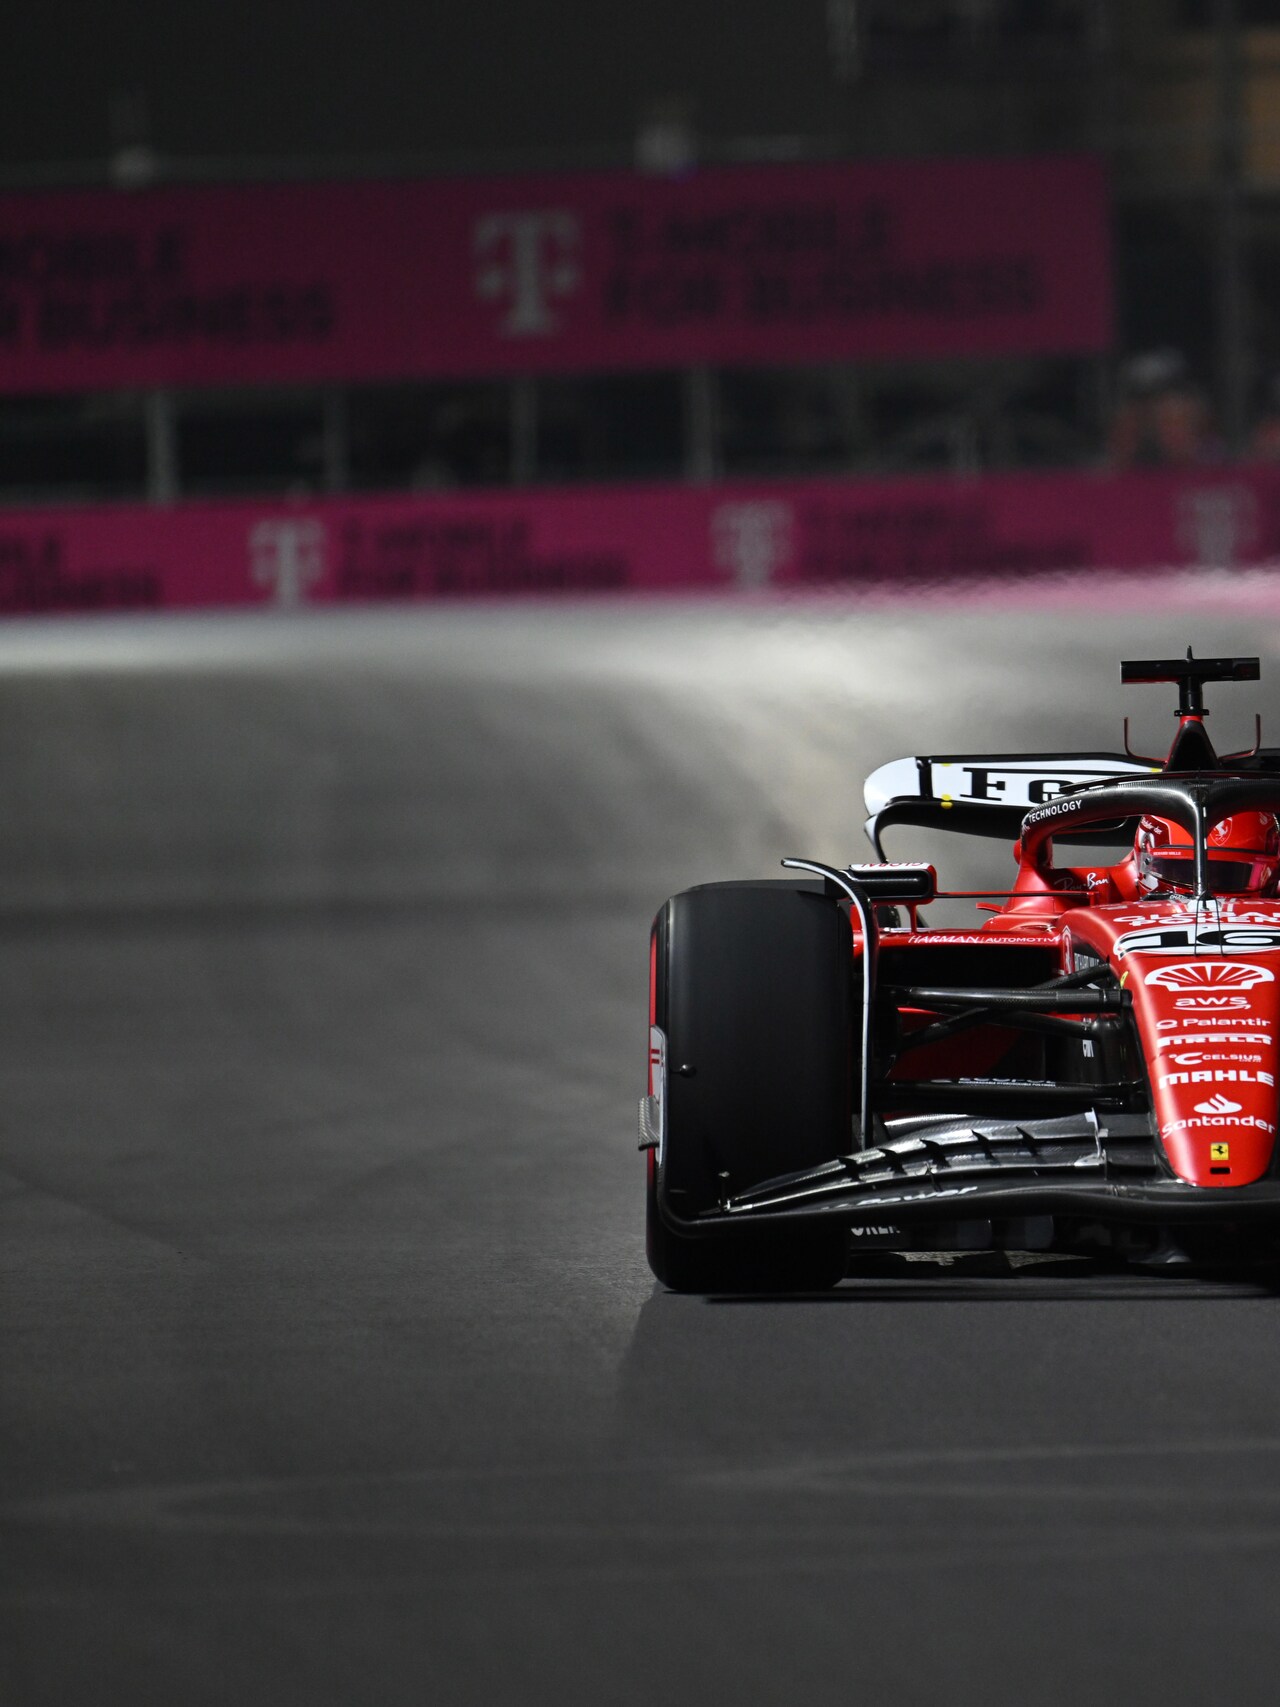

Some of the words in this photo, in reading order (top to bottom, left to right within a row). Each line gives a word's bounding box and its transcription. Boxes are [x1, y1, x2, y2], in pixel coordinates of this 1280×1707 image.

[1028, 799, 1083, 824] TECHNOLOGY
[907, 935, 980, 944] HARMAN
[1175, 996, 1249, 1007] aws
[1183, 1018, 1271, 1027] Palantir
[1156, 1032, 1273, 1049] PIRELLI
[1202, 1053, 1262, 1061] CELSIUS
[1157, 1069, 1275, 1090] MAHLE
[1161, 1115, 1276, 1140] Santander
